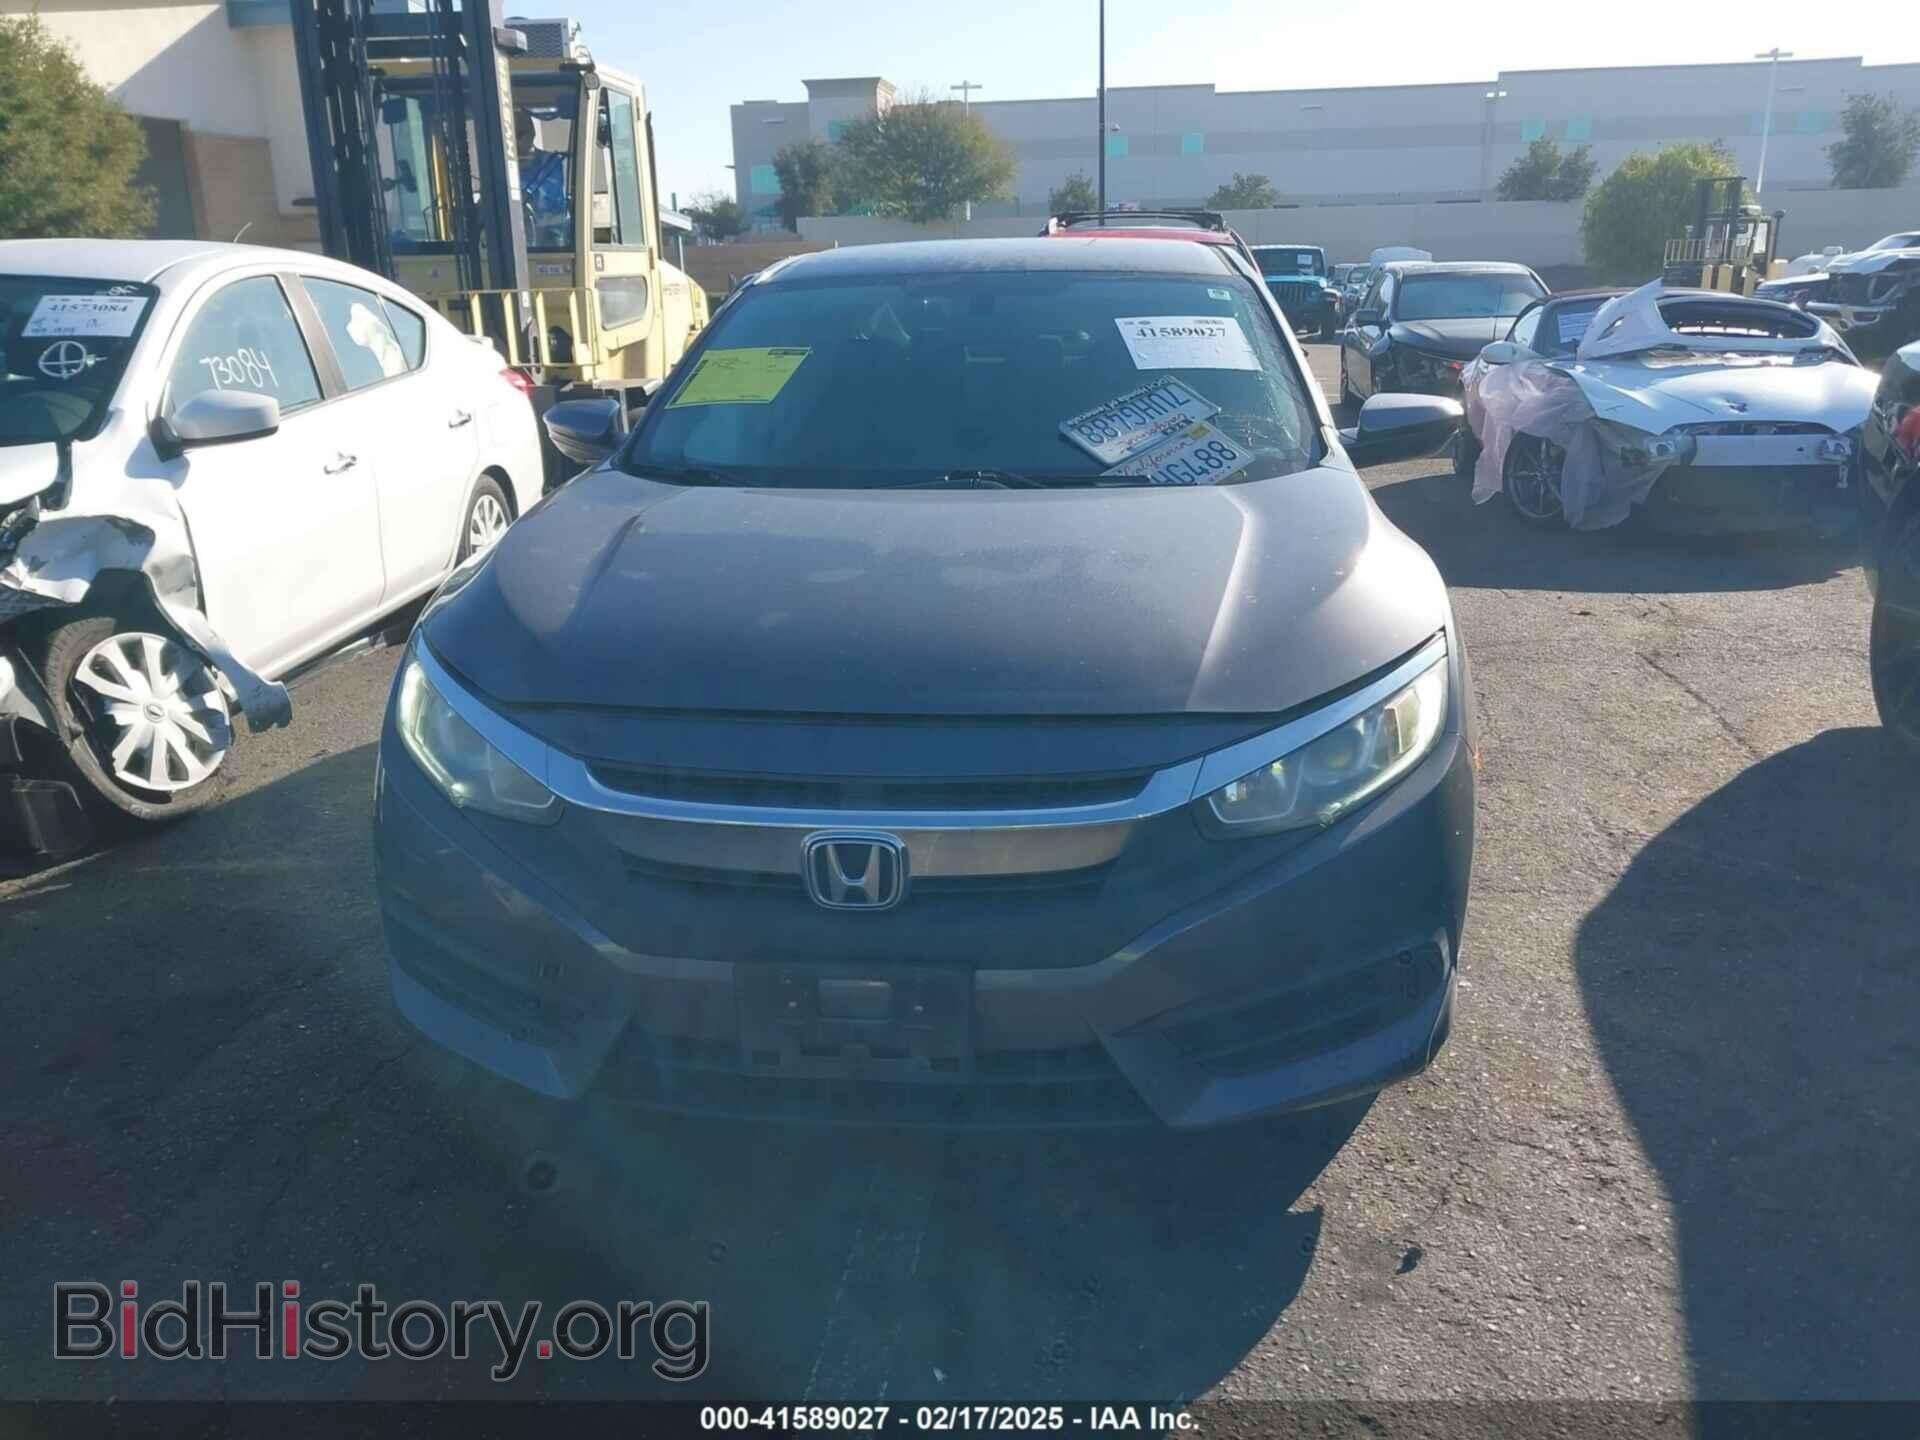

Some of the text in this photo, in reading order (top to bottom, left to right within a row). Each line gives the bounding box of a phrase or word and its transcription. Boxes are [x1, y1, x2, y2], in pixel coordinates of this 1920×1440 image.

[1136, 327, 1225, 338] 41589027
[198, 347, 279, 392] 73084
[1078, 387, 1191, 445] 7UHG488
